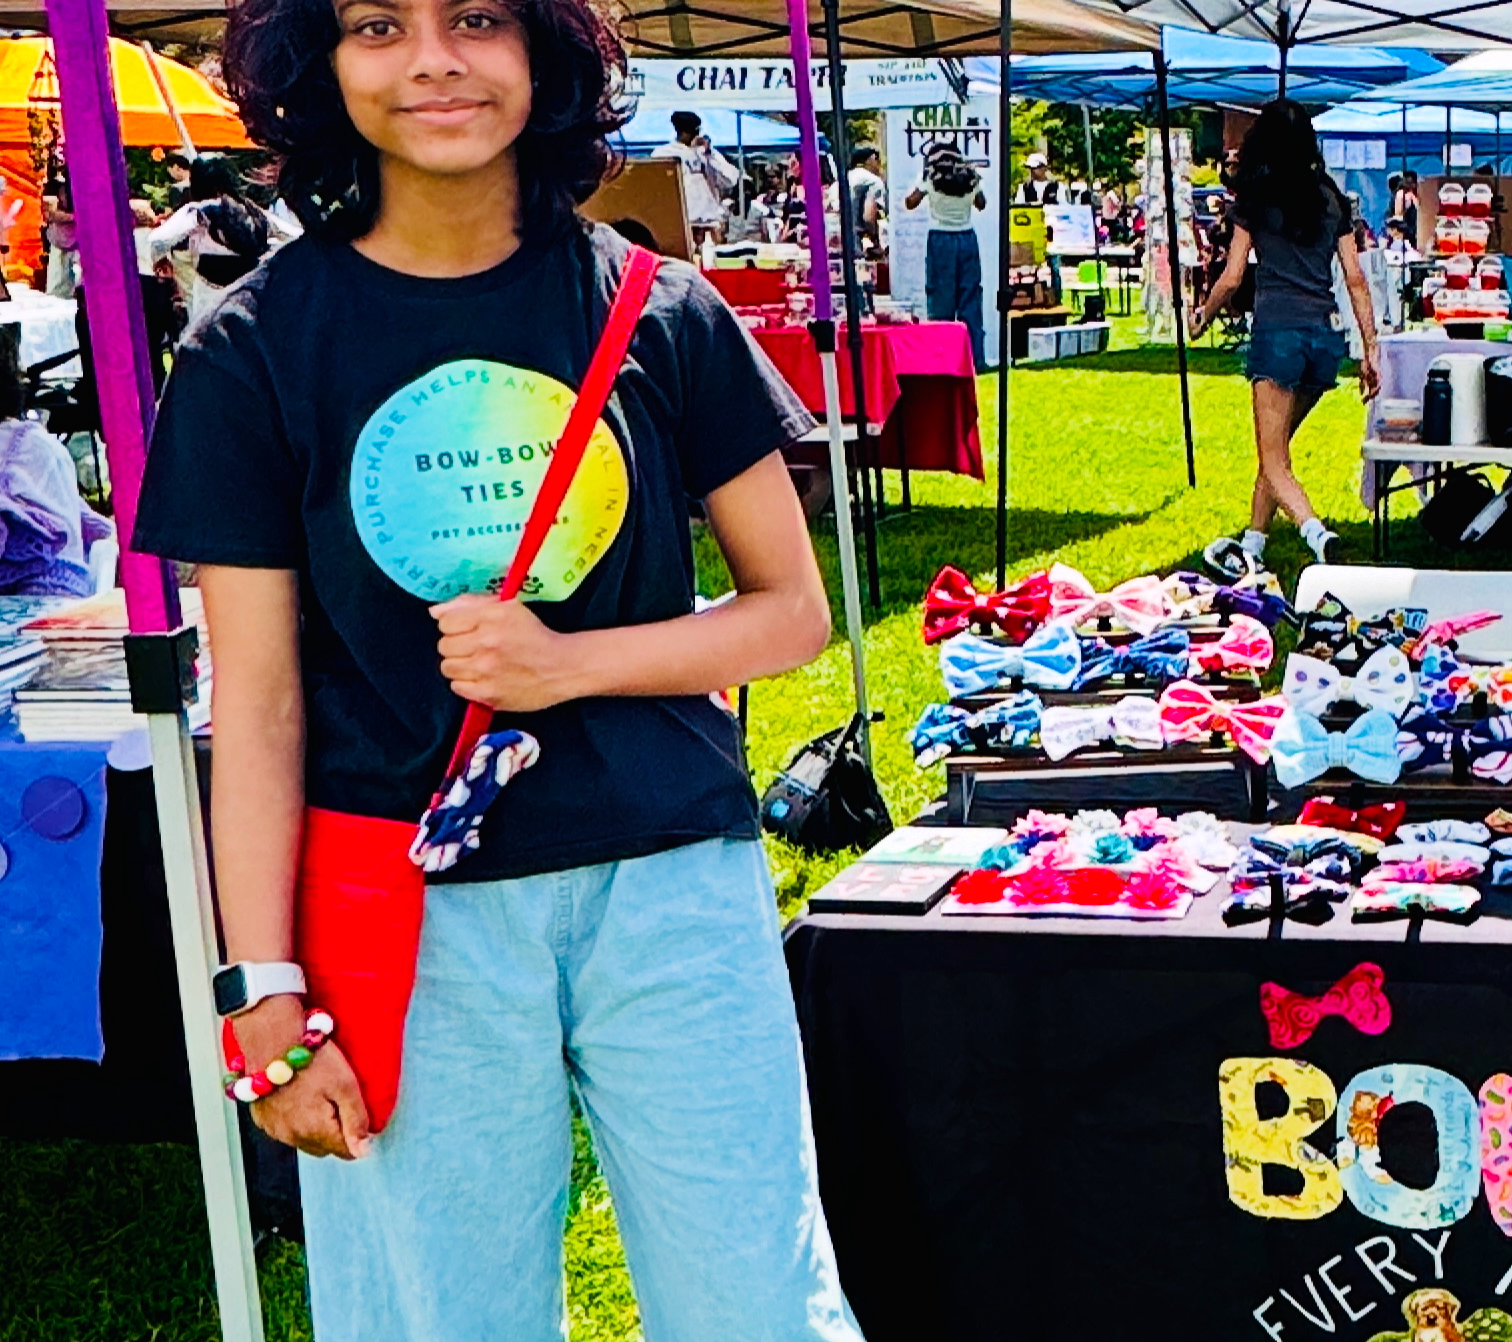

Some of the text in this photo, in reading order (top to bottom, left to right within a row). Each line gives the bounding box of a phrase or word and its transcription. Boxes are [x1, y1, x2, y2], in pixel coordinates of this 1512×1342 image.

[676, 65, 748, 91] CHAI
[912, 104, 962, 128] CHAI
[364, 409, 409, 546] PURCHASE
[410, 369, 491, 407] HELPS
[502, 377, 538, 395] AN
[460, 479, 526, 505] TIES
